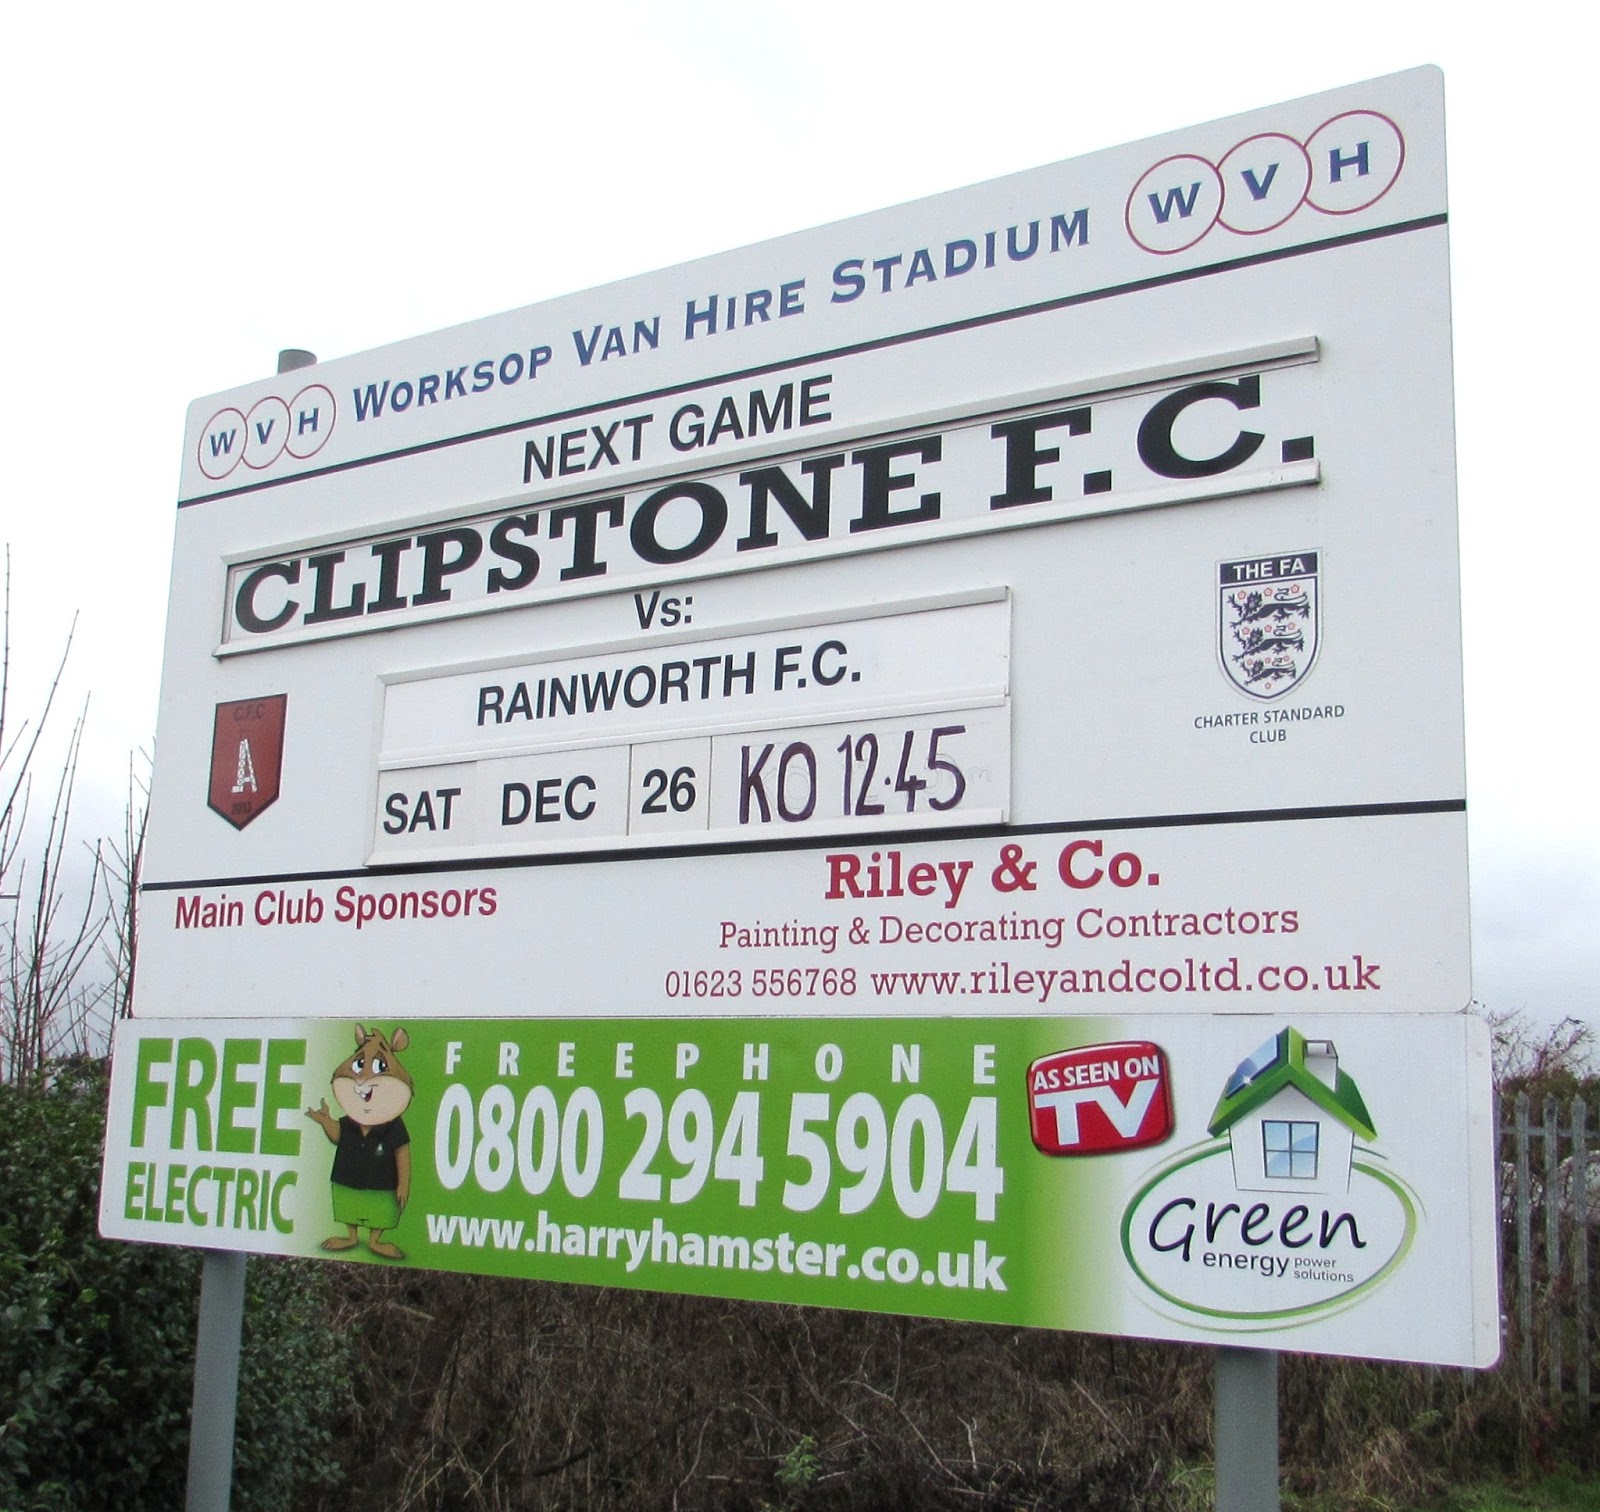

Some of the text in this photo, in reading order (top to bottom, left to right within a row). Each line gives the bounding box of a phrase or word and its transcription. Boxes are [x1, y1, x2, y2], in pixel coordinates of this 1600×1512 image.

[353, 208, 1089, 422] WORKSOP VAN HIRE STADIUM
[522, 375, 832, 484] NEXT GAME
[235, 374, 1315, 633] CLIPSTONE F.C.
[1230, 556, 1307, 582] THE FA
[634, 590, 692, 629] Vs:
[478, 641, 860, 725] RAINWORTH F.C.
[1195, 705, 1344, 728] CHARTER STANDARD
[1250, 730, 1286, 743] CLUB
[384, 767, 695, 834] SAT DEC 26
[740, 742, 816, 824] KO
[175, 885, 498, 930] Main Club Sponsors
[826, 840, 1159, 909] Riley & Co.
[719, 909, 1298, 954] Painting & Decorating Contractors
[665, 954, 1381, 1003] 01623 556768 www.rileyandcoltd.co.uk
[130, 1037, 307, 1156] FREE
[1033, 1054, 1161, 1092] AS SEEN ON
[1034, 1078, 1160, 1145] TV
[435, 1084, 1003, 1221] 0800 294 5904
[123, 1161, 298, 1234] ELECTRIC
[1149, 1197, 1367, 1262] Green
[427, 1211, 1006, 1290] www.harryhamster.co.uk
[1203, 1252, 1289, 1277] energy
[1292, 1269, 1356, 1283] solutions
[1293, 1256, 1338, 1270] power
